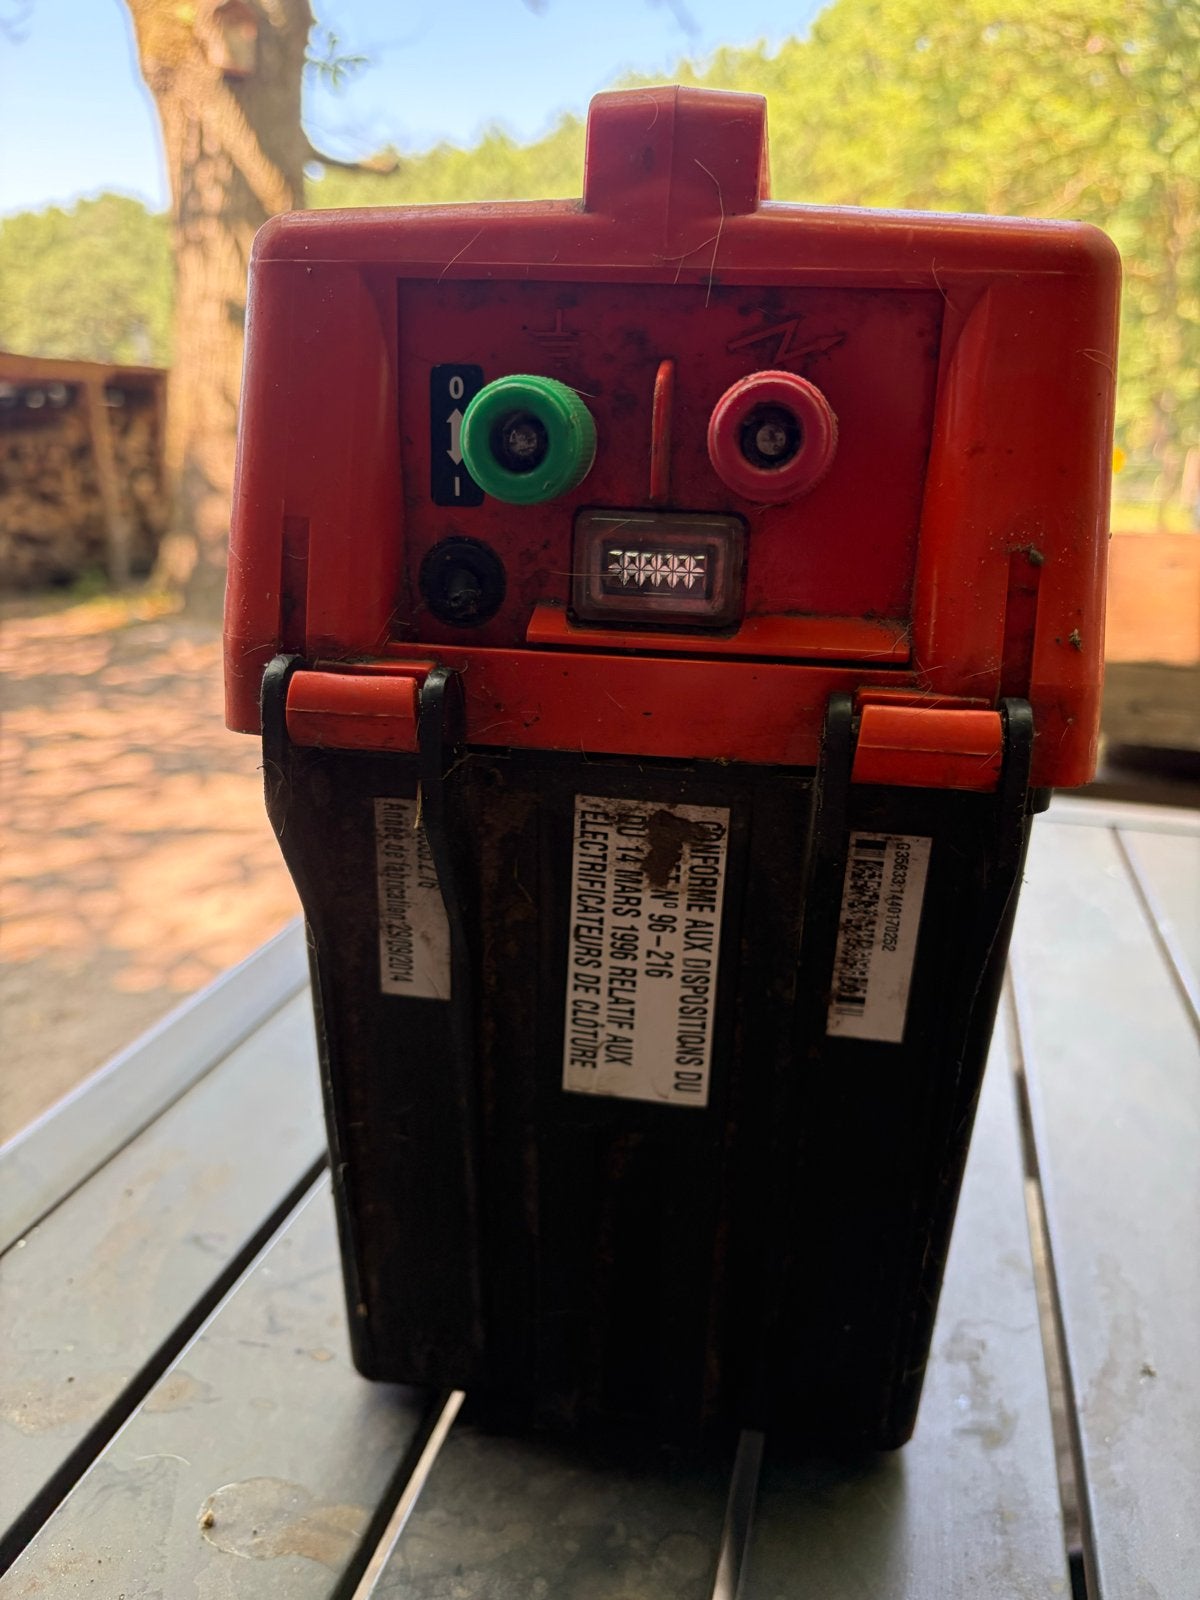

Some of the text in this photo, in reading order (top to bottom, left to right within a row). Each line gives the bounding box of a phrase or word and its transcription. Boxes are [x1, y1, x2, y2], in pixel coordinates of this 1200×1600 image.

[449, 376, 465, 400] 0
[384, 842, 410, 859] de
[604, 813, 647, 1067] DU 14 MARS 1996 RELATIF AUX
[674, 821, 725, 1093] CONFORME AUX DISPOSITIONS DU
[573, 972, 601, 996] DE
[570, 999, 605, 1070] CLÔTURE
